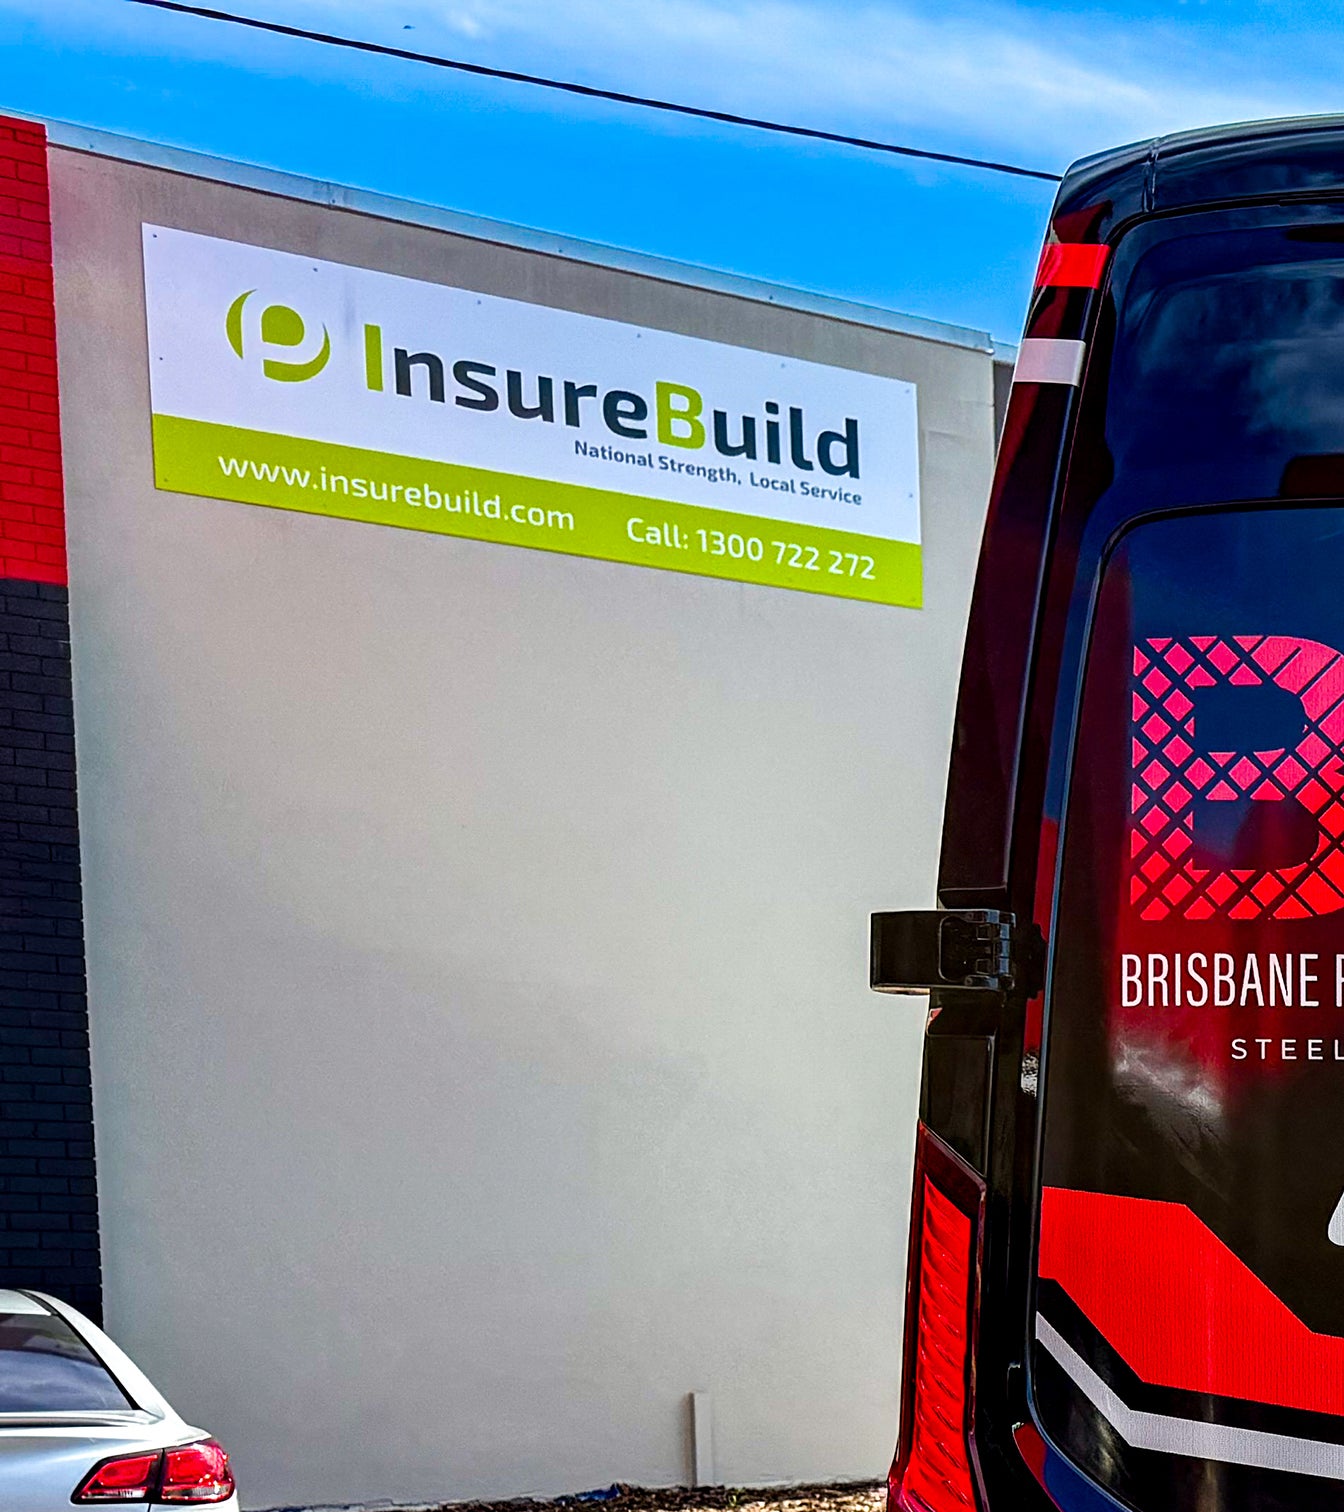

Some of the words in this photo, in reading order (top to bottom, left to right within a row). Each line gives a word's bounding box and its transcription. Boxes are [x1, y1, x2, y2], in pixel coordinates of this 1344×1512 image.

[363, 323, 861, 479] InsureBuild
[217, 453, 575, 531] www.insurebuild.com
[626, 517, 689, 550] Call:
[696, 528, 763, 561] 1300
[771, 541, 820, 571] 722
[828, 551, 876, 580] 272
[574, 440, 654, 469] National
[658, 455, 742, 486] Strength,
[749, 471, 797, 494] Local
[800, 481, 862, 505] Service
[1121, 952, 1320, 1007] BRISBANE
